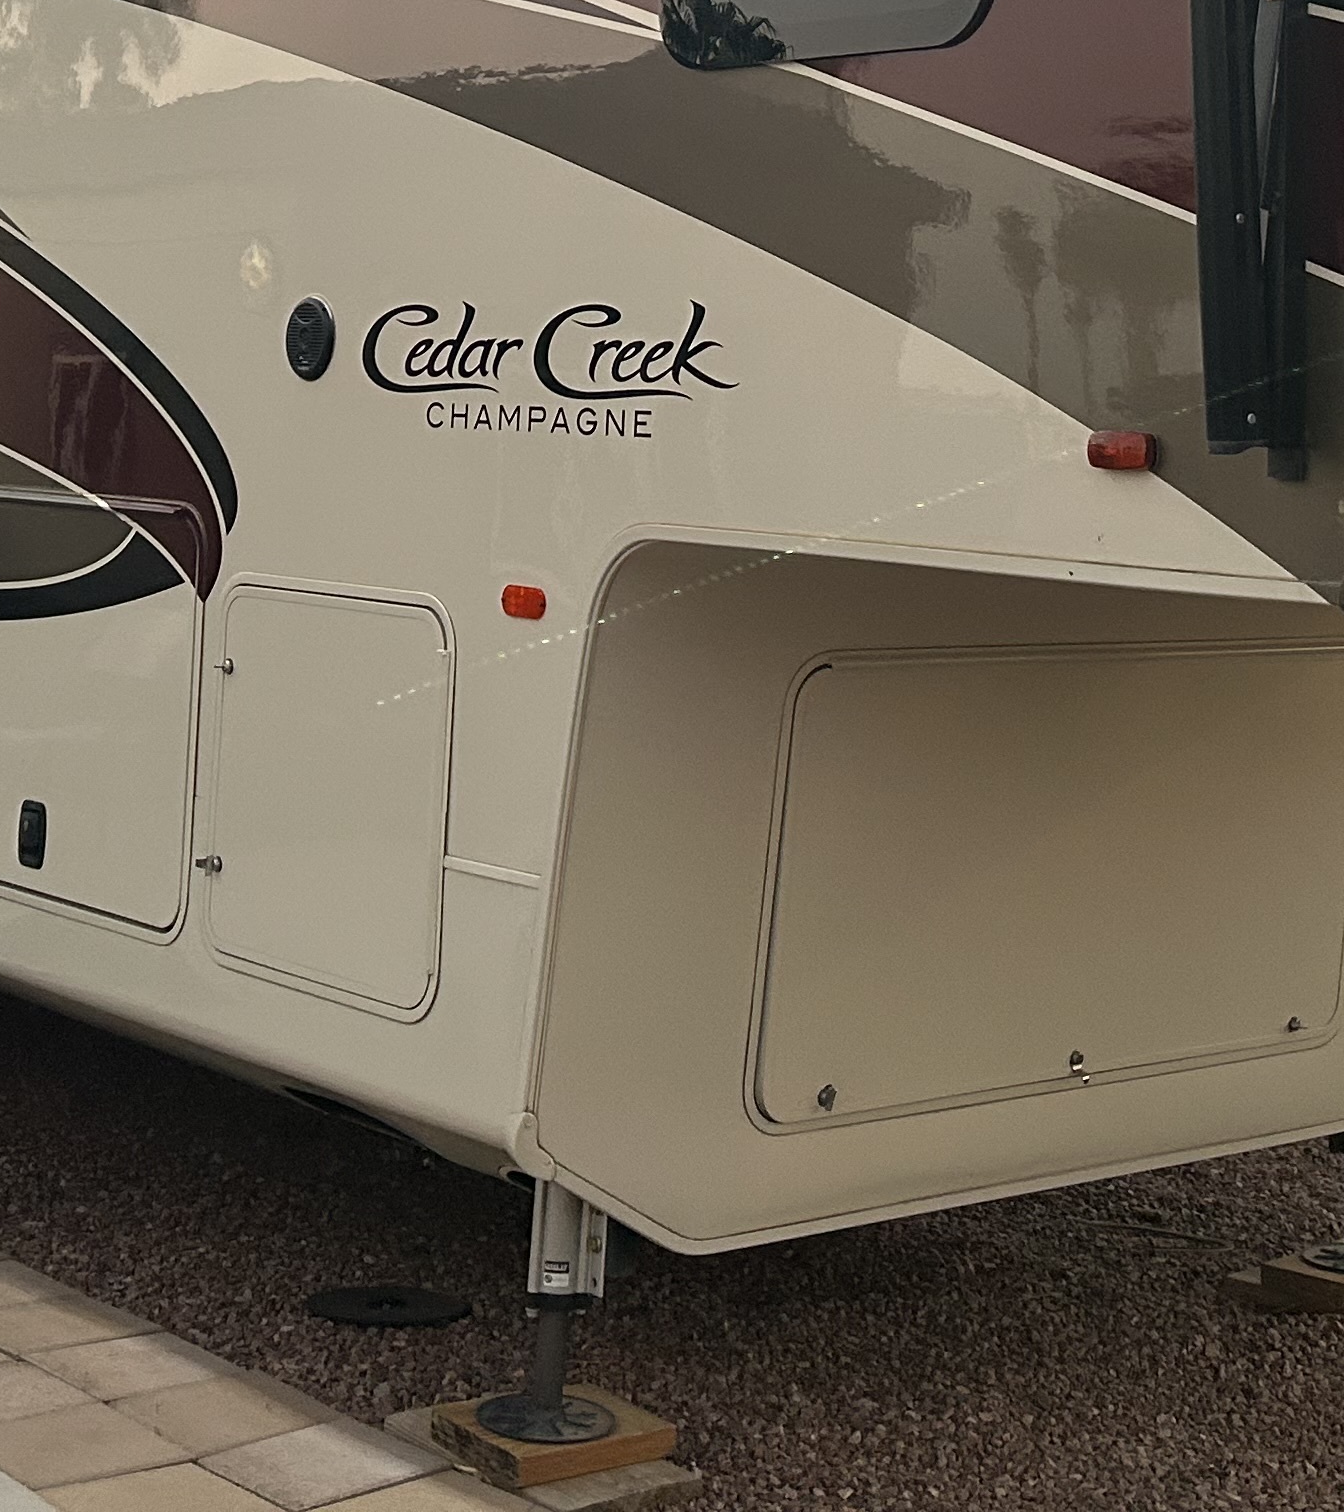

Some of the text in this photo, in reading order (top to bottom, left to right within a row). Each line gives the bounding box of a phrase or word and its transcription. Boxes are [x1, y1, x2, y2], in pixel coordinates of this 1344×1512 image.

[361, 299, 741, 401] Cedar Creek
[425, 401, 653, 439] CHAMPAGNE
